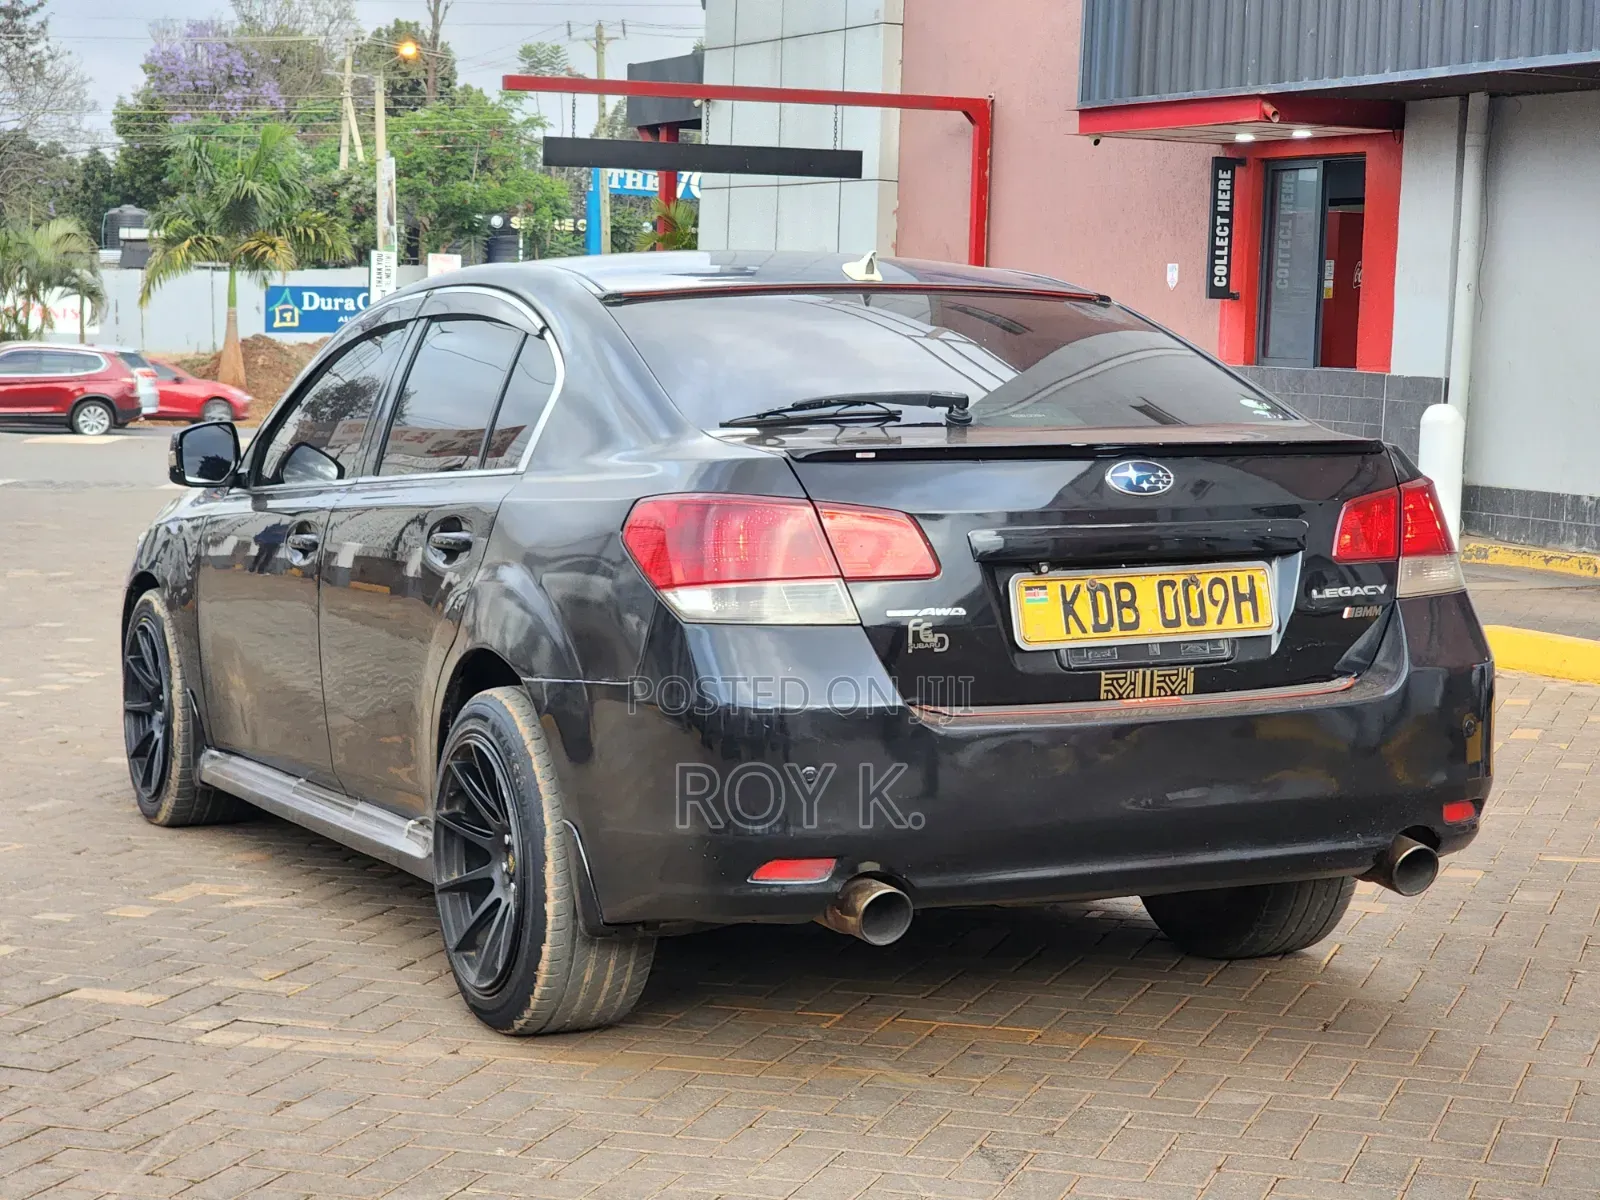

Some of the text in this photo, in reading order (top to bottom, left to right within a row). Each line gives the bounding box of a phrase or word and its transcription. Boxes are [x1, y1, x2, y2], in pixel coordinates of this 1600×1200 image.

[608, 168, 659, 191] THE
[1213, 169, 1232, 287] COLLECT HERE
[1312, 584, 1387, 599] LEGACY
[917, 607, 966, 616] AWD
[1060, 575, 1260, 634] KDB 009H
